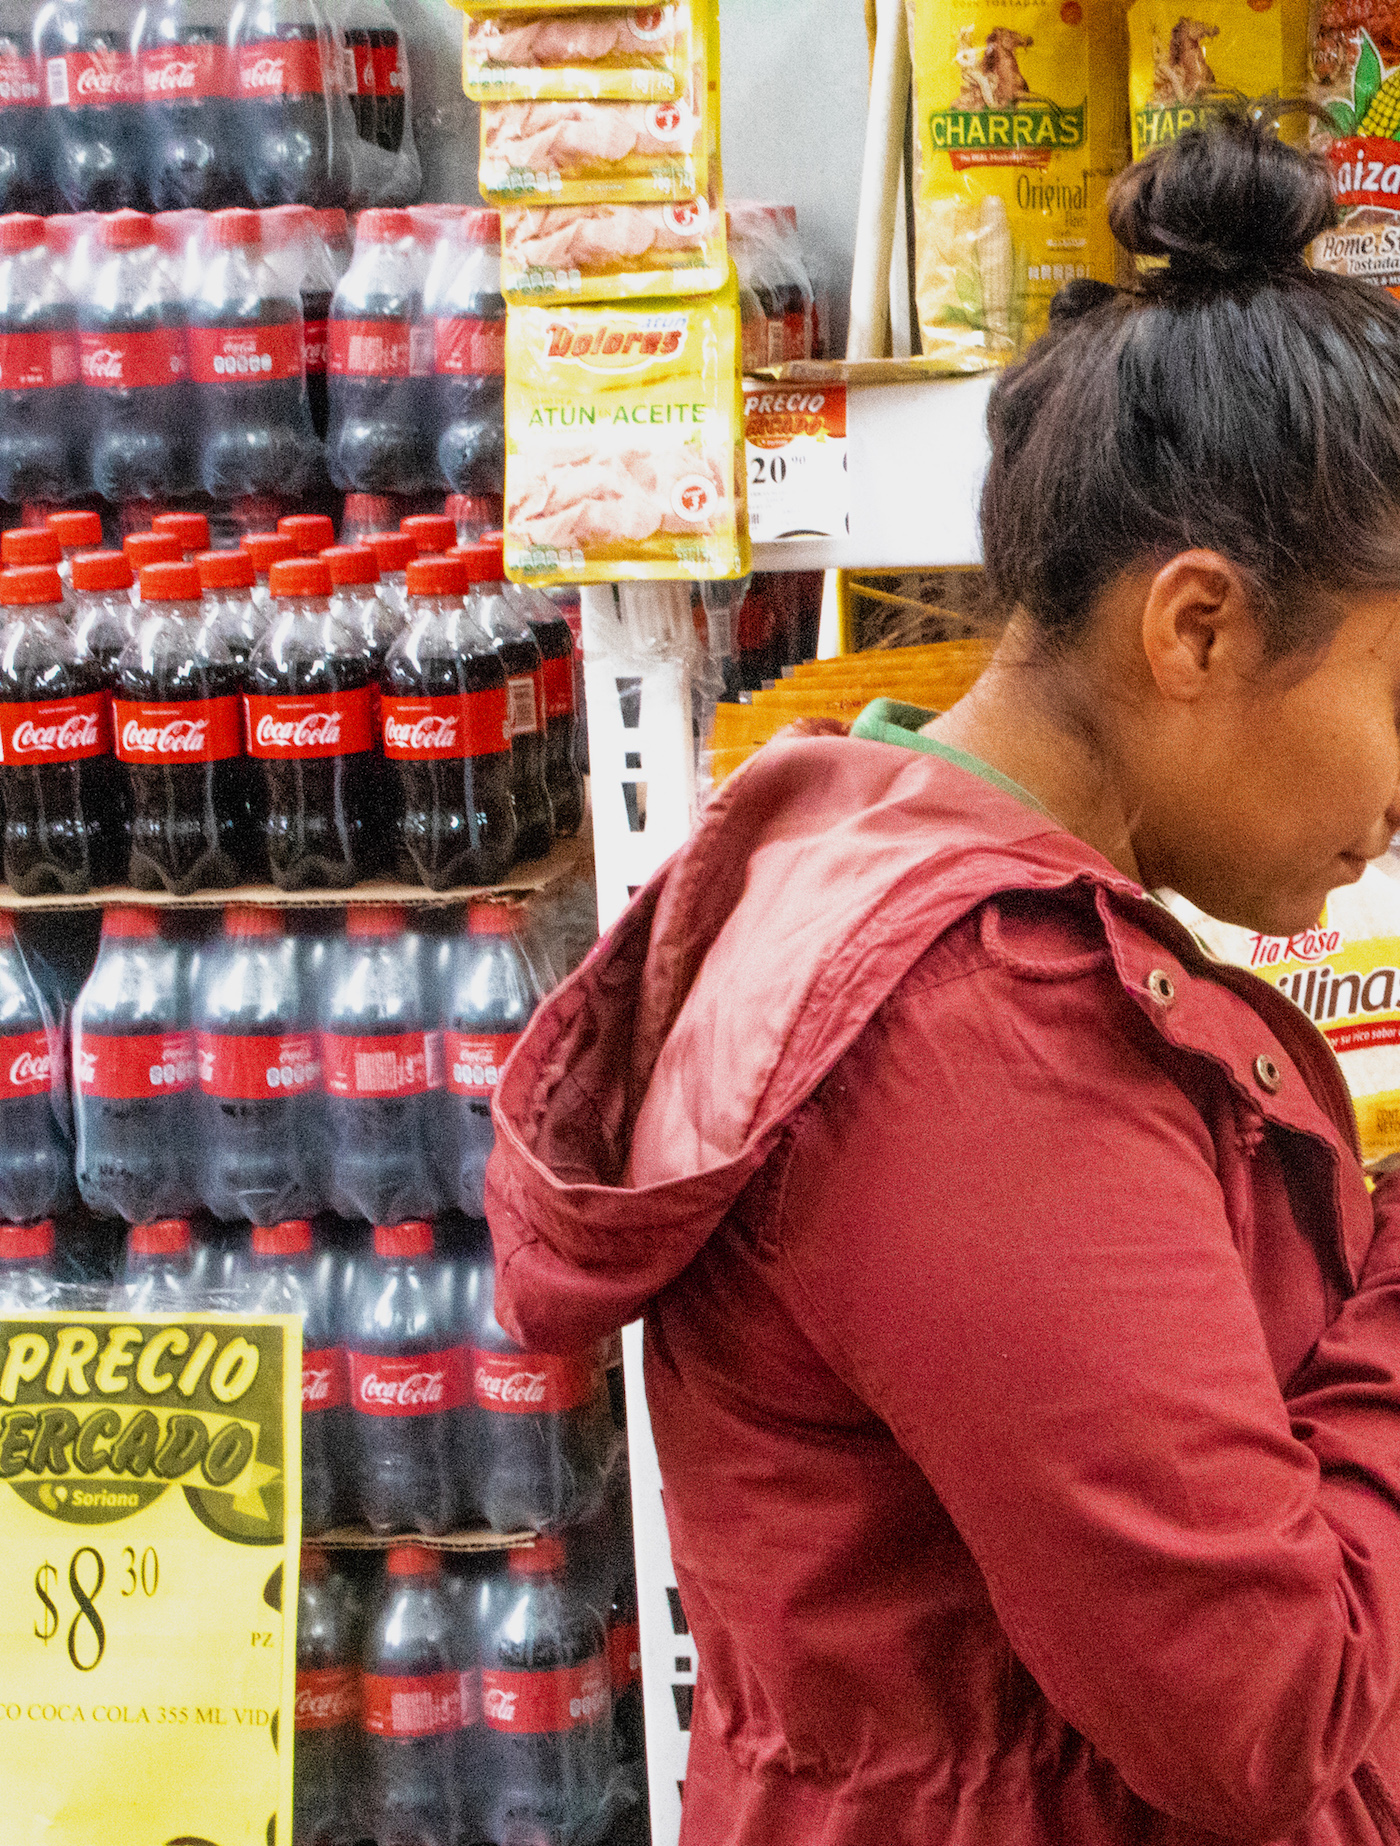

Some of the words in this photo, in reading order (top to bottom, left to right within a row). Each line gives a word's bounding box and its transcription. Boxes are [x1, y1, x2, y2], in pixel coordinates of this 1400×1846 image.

[930, 113, 1080, 146] CHARRAS
[1016, 170, 1089, 216] Original
[1322, 236, 1375, 260] Home
[545, 321, 683, 358] Dolores
[528, 405, 596, 428] ATUN
[612, 403, 706, 425] ACEITE
[744, 393, 826, 417] PRECIO
[751, 456, 787, 484] 20
[12, 712, 99, 753] Coca-Cola
[122, 718, 210, 752] Coca-Cola
[257, 711, 343, 746] Coca-Cola
[385, 715, 460, 749] Coca-Cola
[1283, 928, 1340, 961] Rosa
[1371, 1027, 1397, 1040] sabor
[1, 1326, 260, 1405] PRECIO
[360, 1371, 444, 1406] Coca-Cola
[71, 1487, 140, 1509] Soriana
[121, 1546, 160, 1599] 30
[250, 1631, 275, 1649] PZ
[27, 1703, 87, 1723] COCA
[92, 1704, 152, 1724] COLA
[156, 1706, 190, 1725] 355
[195, 1707, 228, 1726] ML
[233, 1708, 271, 1727] VID
